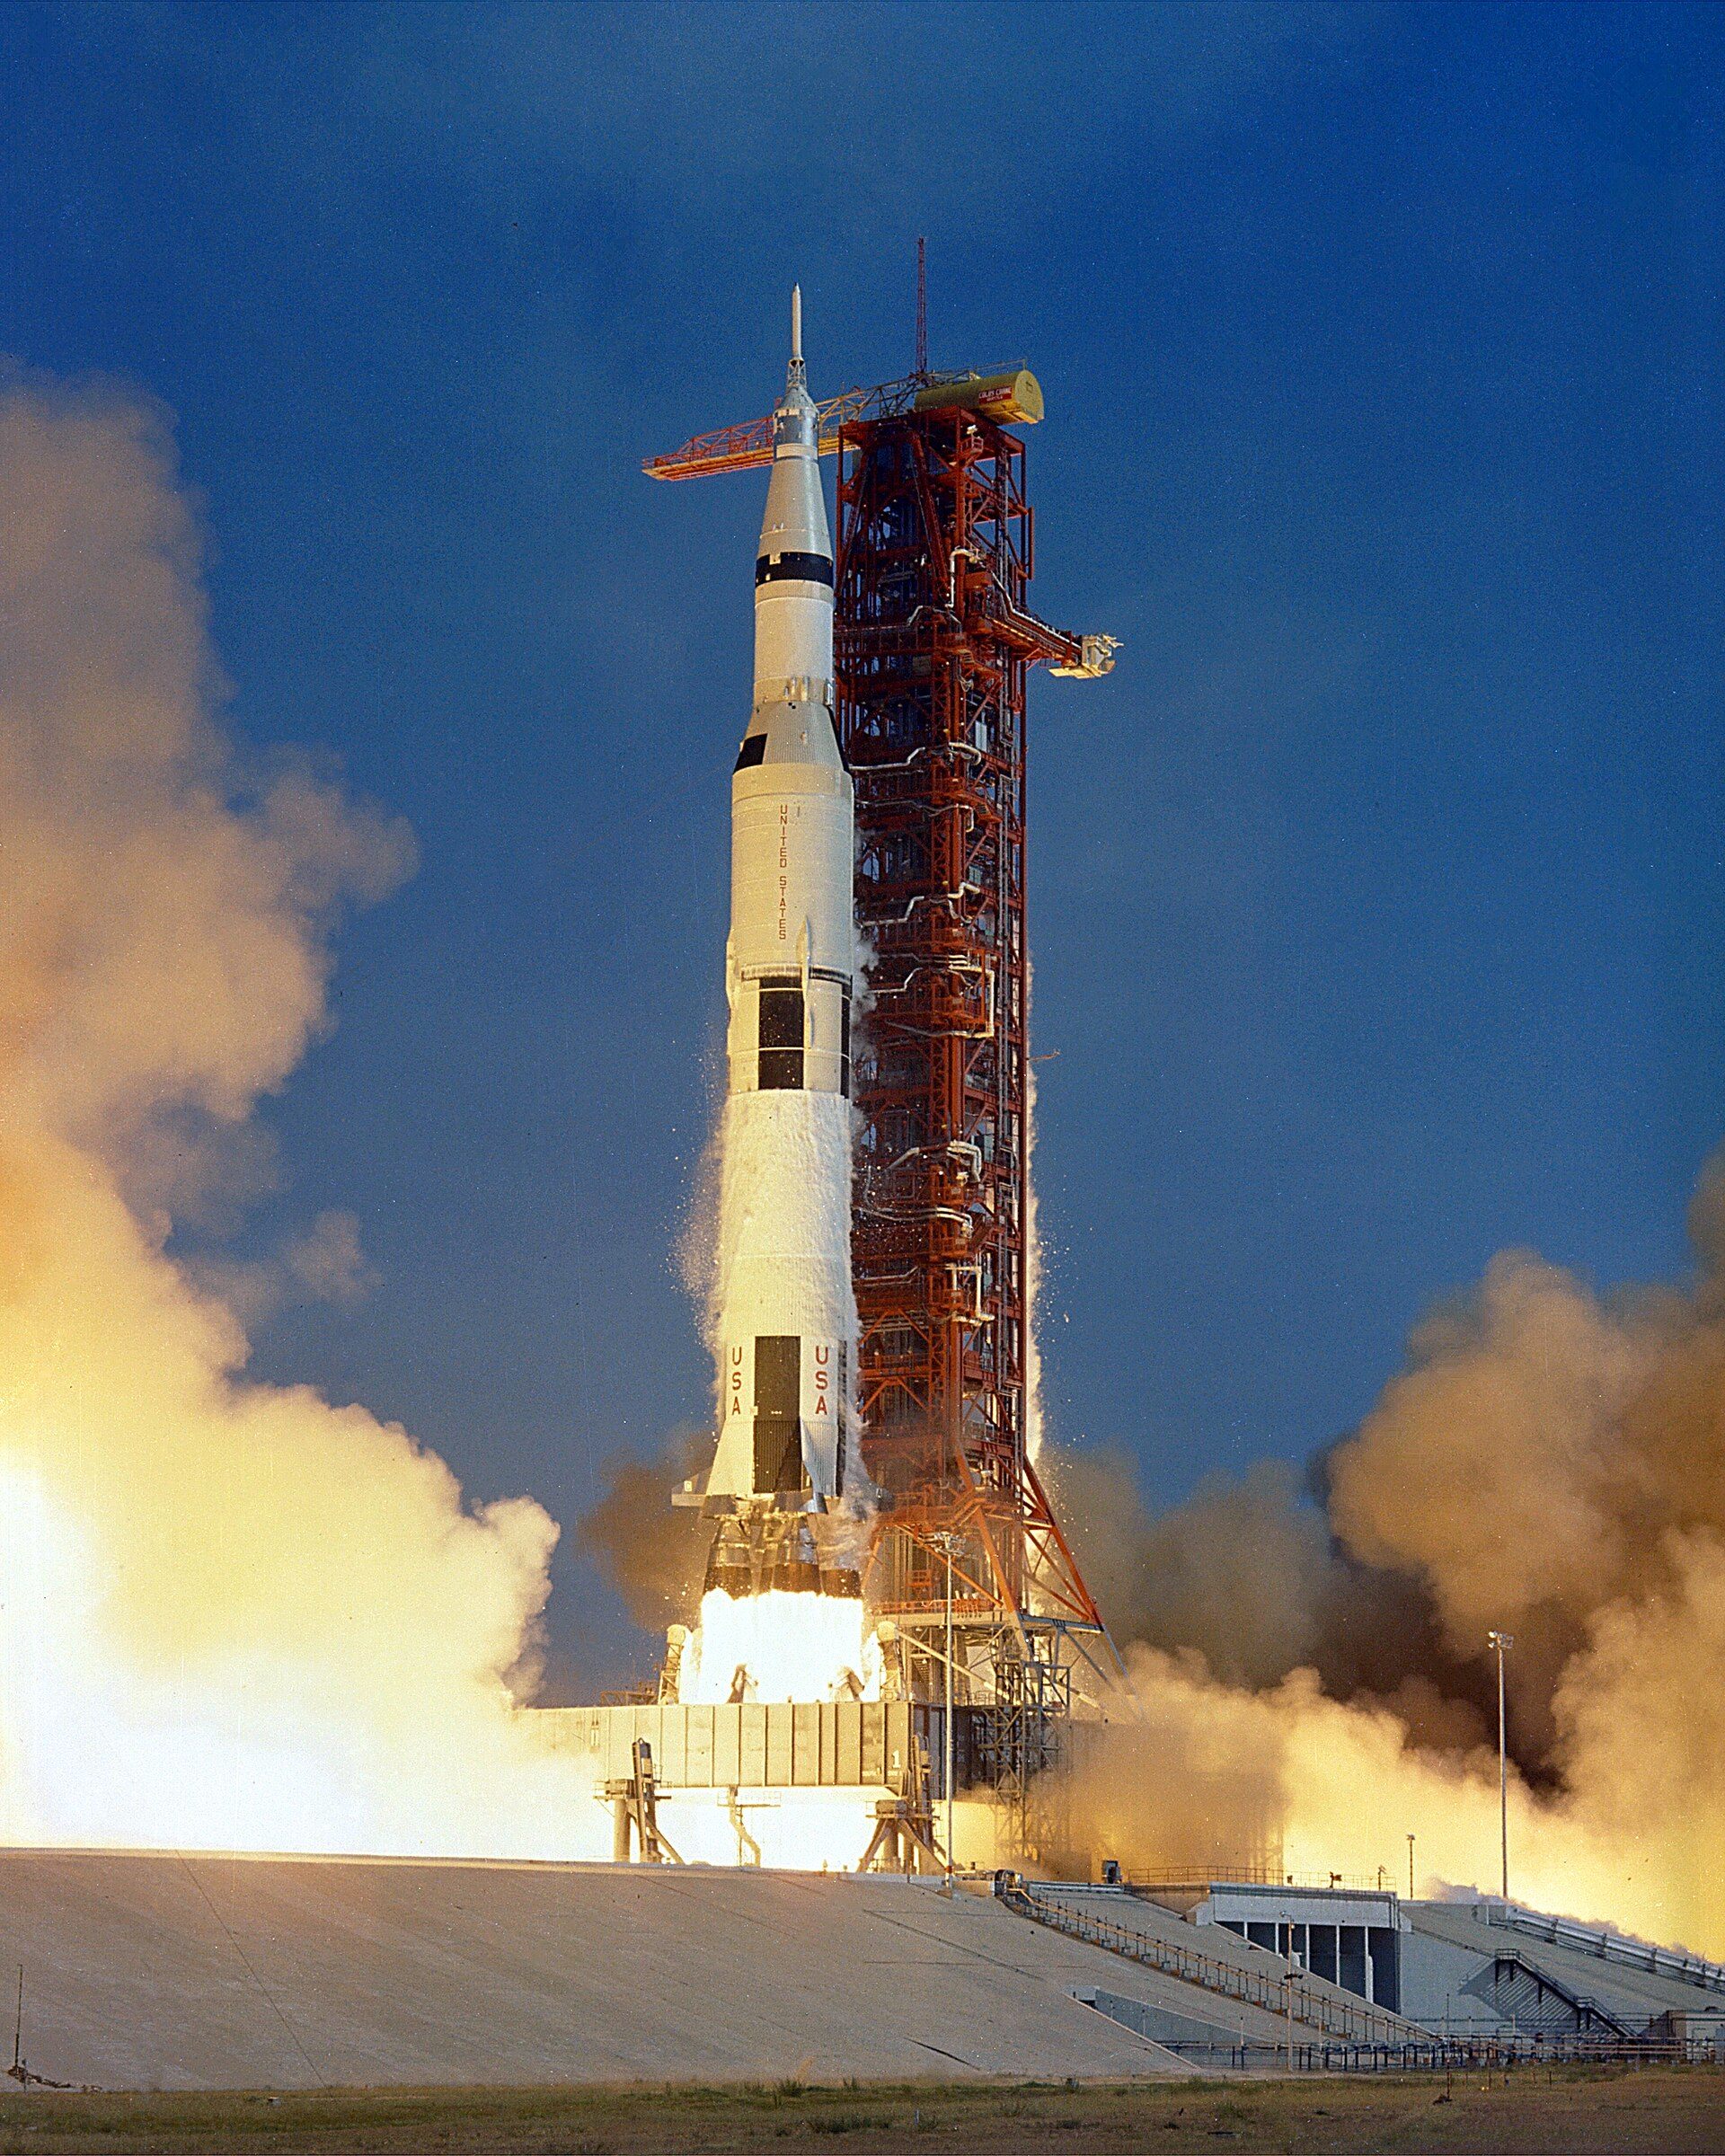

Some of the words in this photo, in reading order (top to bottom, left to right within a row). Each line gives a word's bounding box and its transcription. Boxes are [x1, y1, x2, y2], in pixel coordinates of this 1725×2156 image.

[779, 804, 788, 869] UNITED
[779, 876, 787, 940] STATES
[731, 1346, 742, 1416] USA
[815, 1345, 829, 1416] USA
[892, 1749, 901, 1769] 1
